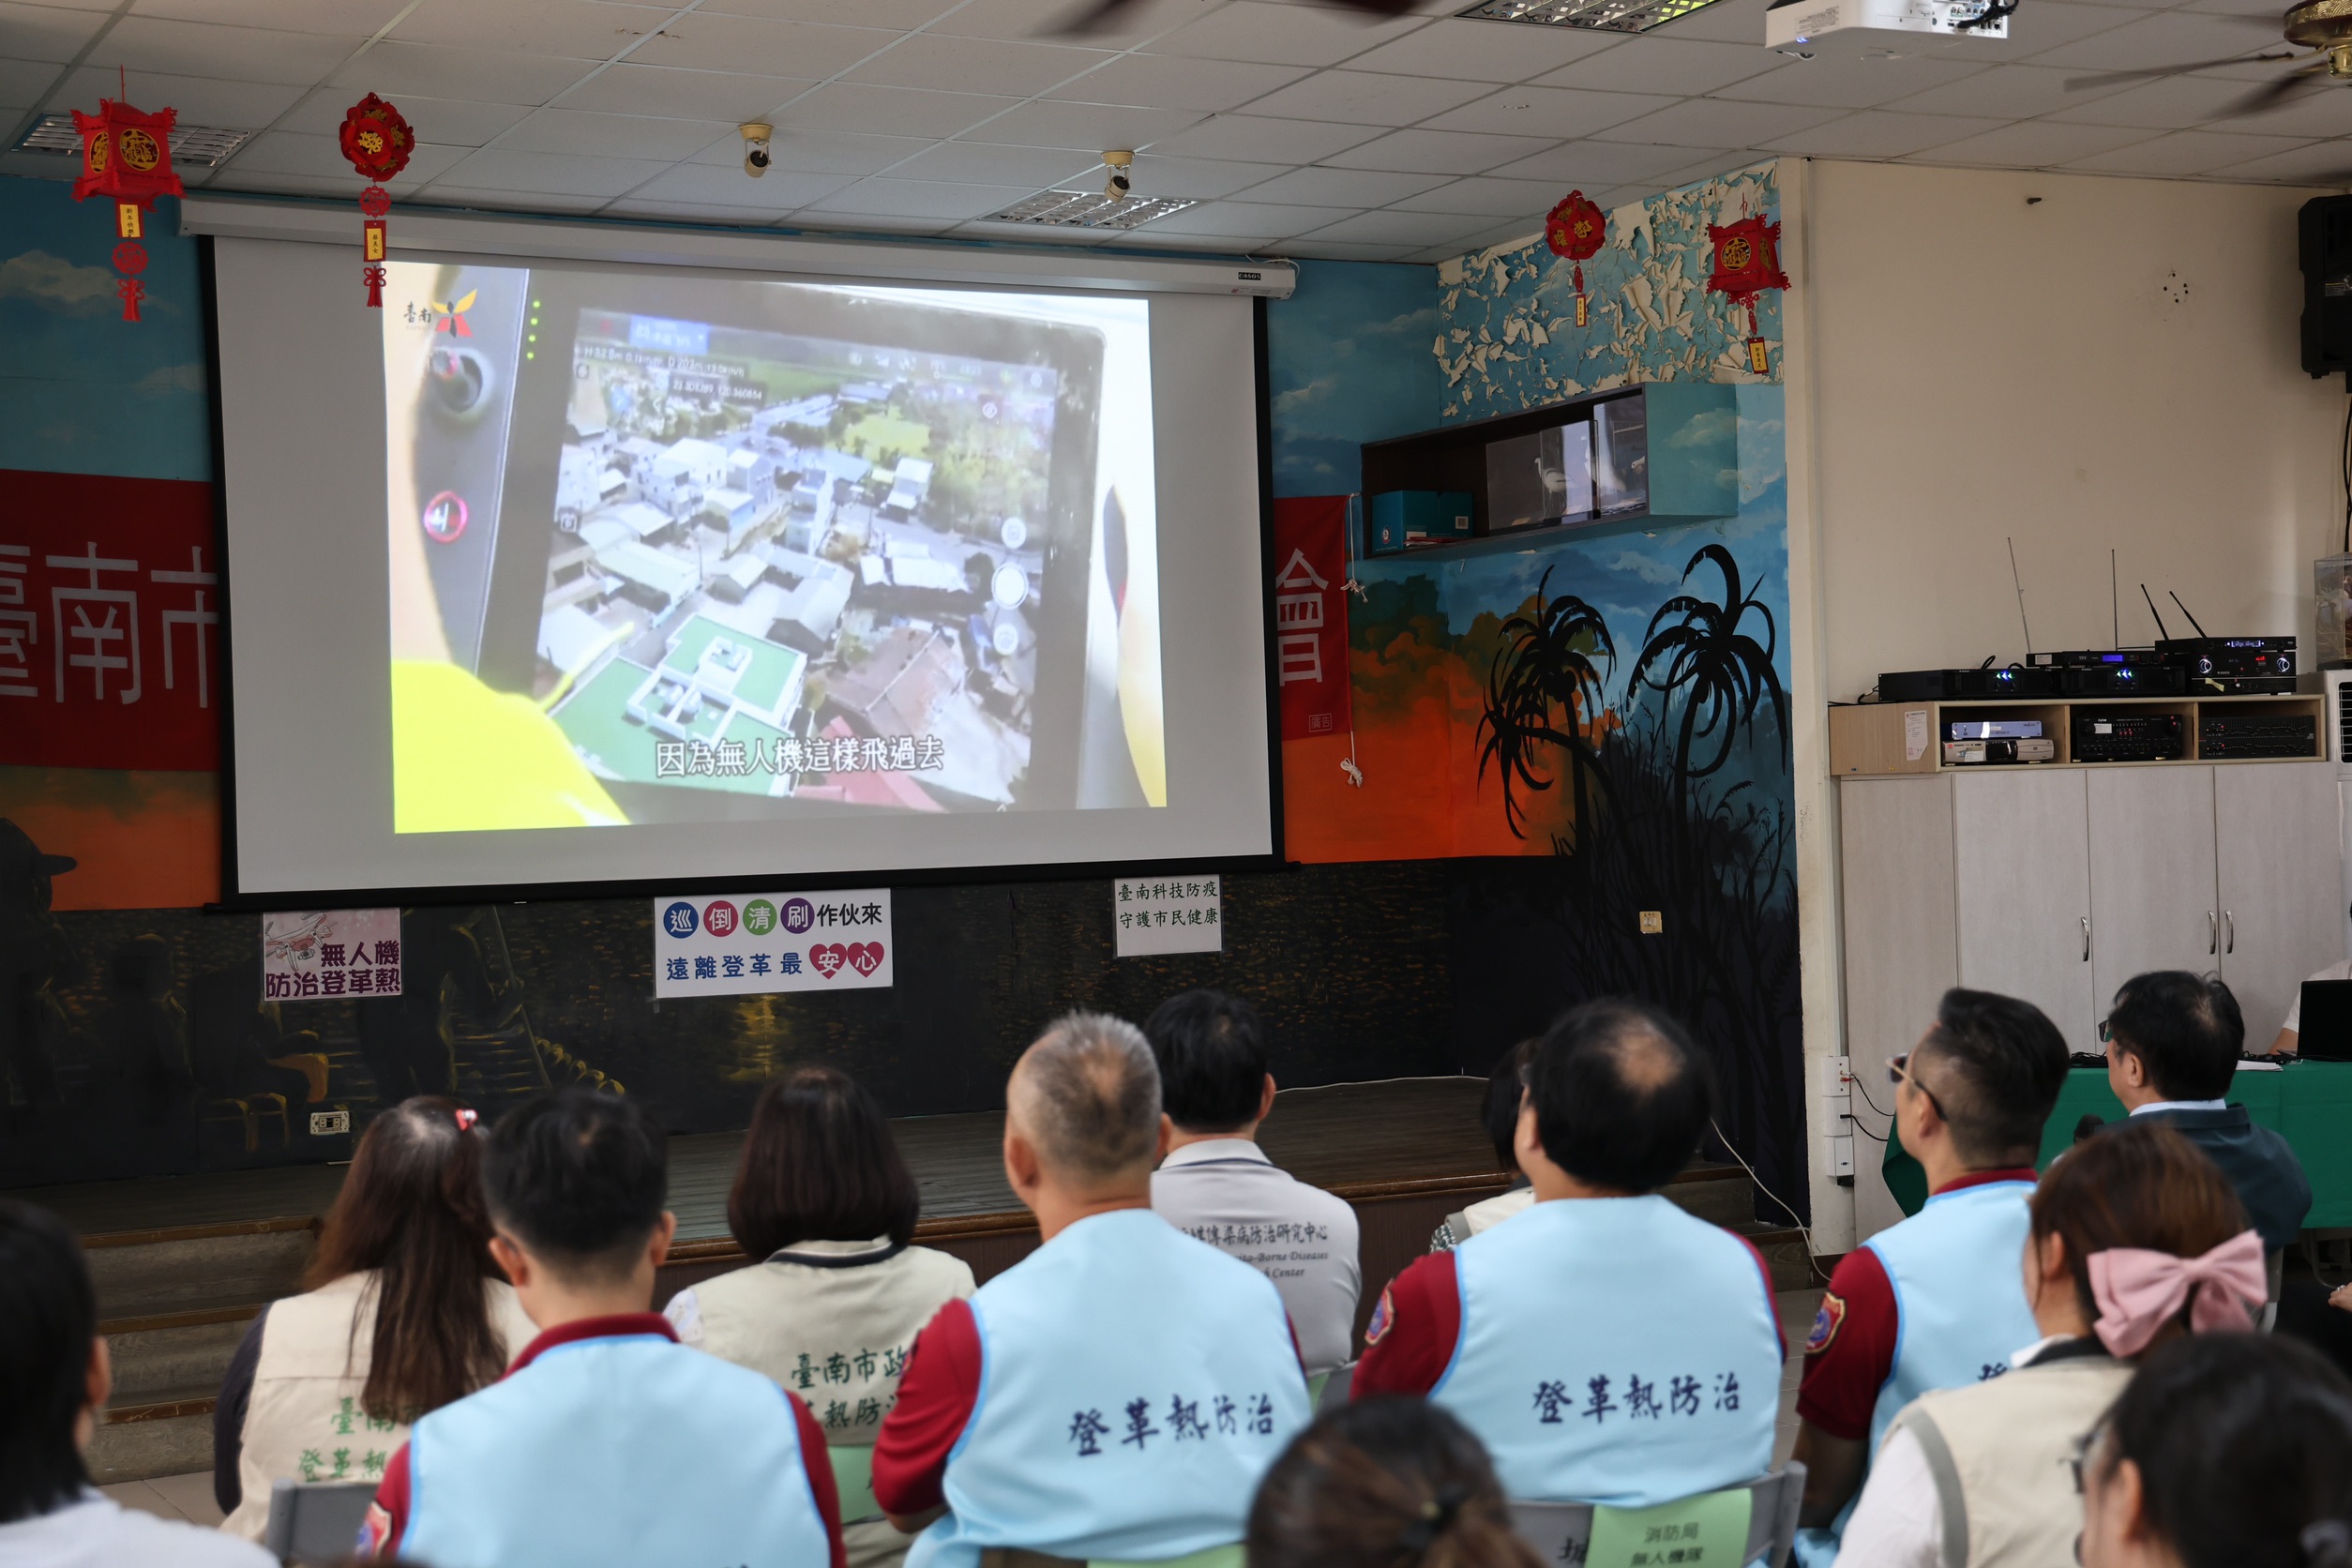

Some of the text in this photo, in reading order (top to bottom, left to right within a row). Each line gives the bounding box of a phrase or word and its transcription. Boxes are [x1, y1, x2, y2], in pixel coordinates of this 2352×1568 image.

[1275, 547, 1329, 686] 會
[1310, 716, 1331, 729] 廣告
[656, 736, 944, 776] 因為無人機這樣飛過去
[1118, 881, 1218, 901] 臺南科技防疫
[670, 901, 882, 933] 巡倒清刷作伙來
[1119, 907, 1218, 928] 守護市民健康
[321, 940, 400, 968] 無人機
[666, 950, 878, 981] 遠離登革最安心
[265, 967, 400, 998] 防治登革熱
[1289, 1250, 1329, 1261] Diseases
[1272, 1267, 1305, 1278] Center
[1533, 1372, 1741, 1424] 登革熱防治
[1069, 1393, 1274, 1456] 登革熱防治
[1644, 1521, 1699, 1543] 消防局
[1630, 1546, 1704, 1567] 無人機隊
